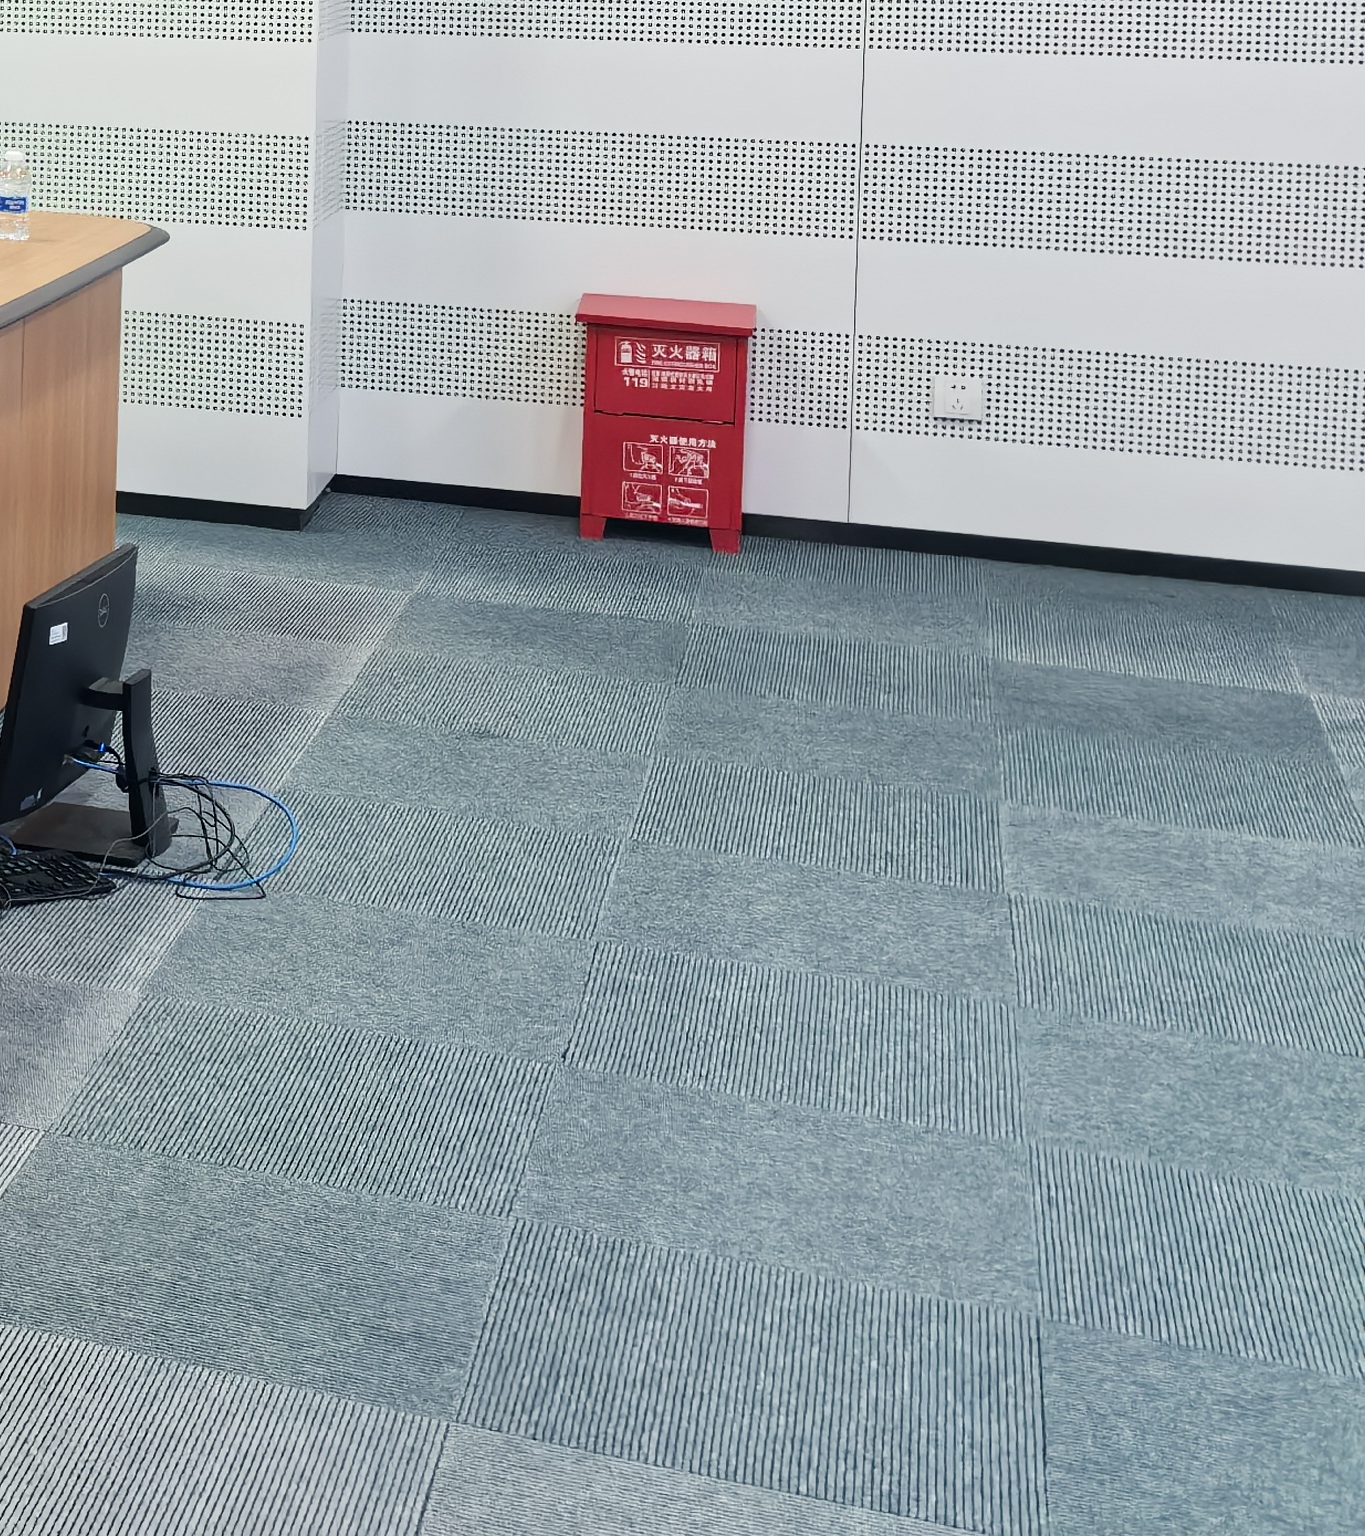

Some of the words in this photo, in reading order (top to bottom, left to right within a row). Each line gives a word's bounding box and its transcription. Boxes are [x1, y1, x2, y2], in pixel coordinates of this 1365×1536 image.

[651, 344, 717, 361] 灭火器箱
[623, 377, 648, 388] 119
